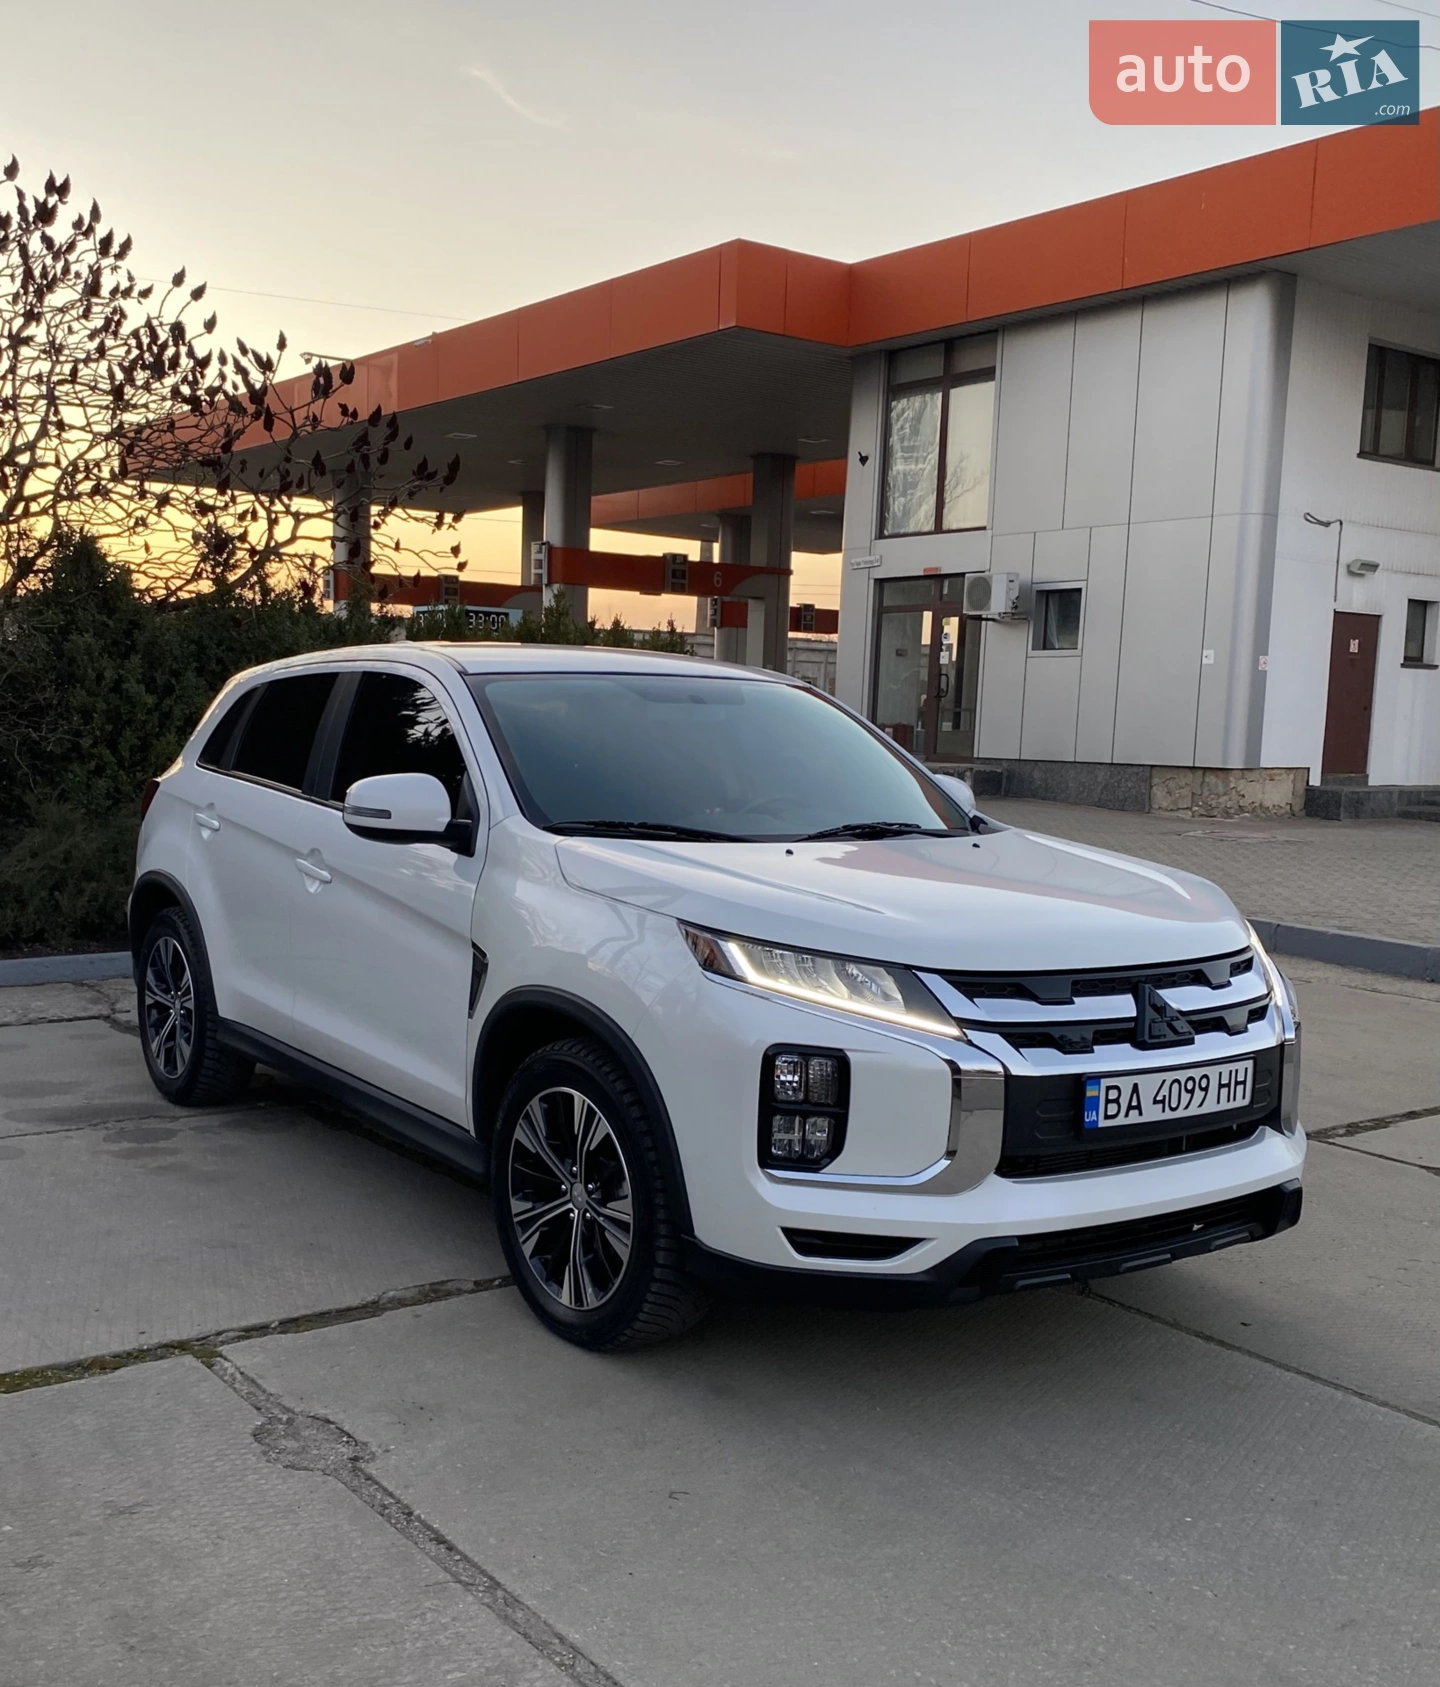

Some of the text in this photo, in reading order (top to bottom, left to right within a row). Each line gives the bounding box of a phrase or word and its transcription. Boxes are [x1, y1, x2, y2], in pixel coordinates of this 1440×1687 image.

[713, 571, 722, 588] 6
[1103, 1067, 1249, 1121] BA 4099 HH
[1084, 1111, 1098, 1122] UA
